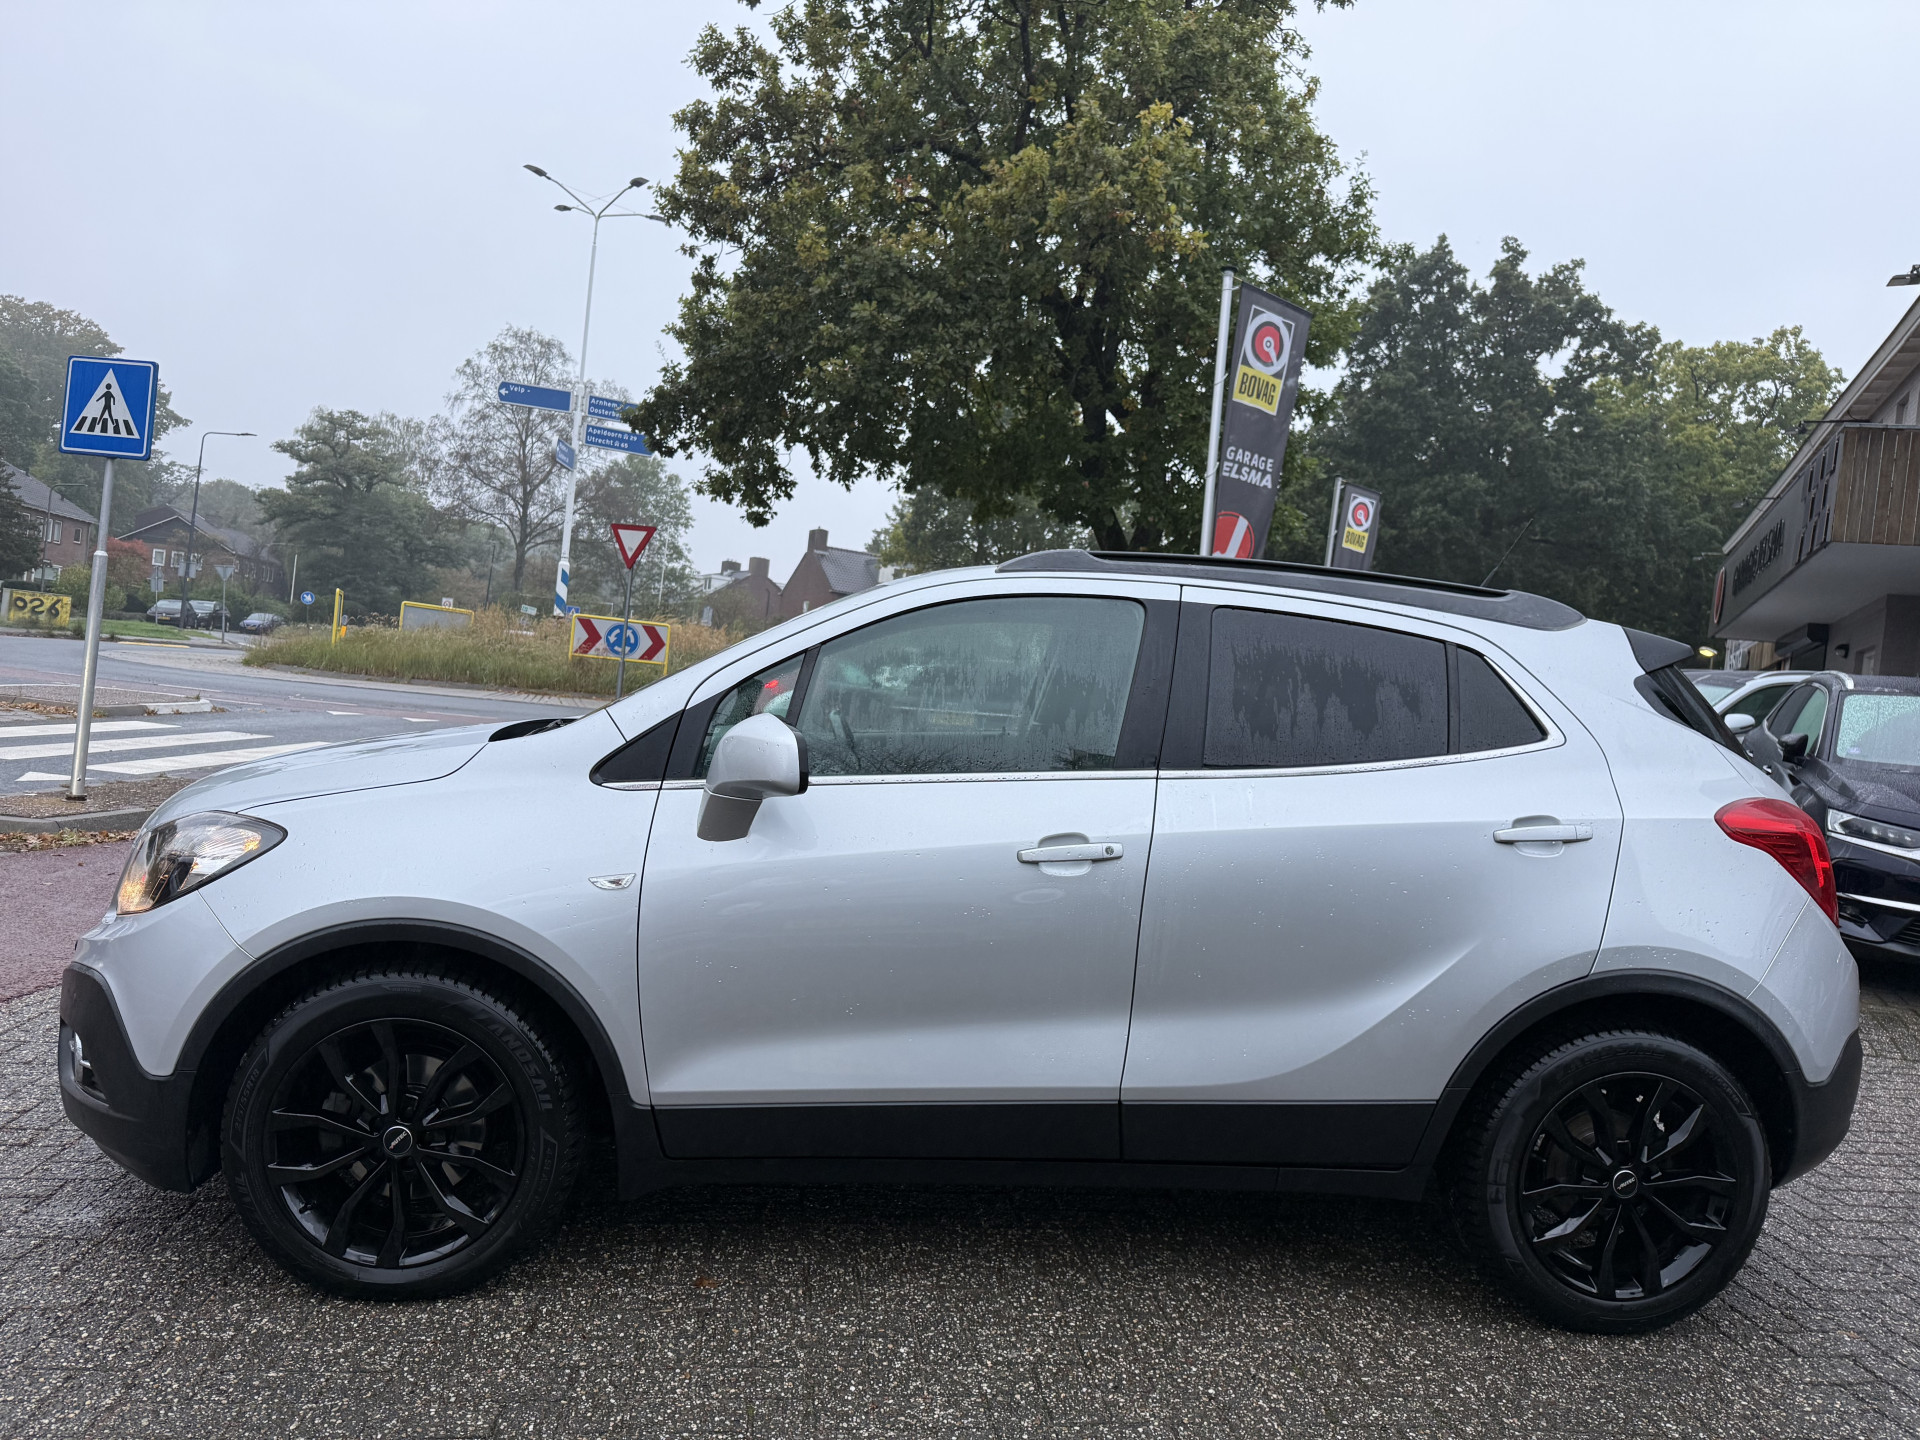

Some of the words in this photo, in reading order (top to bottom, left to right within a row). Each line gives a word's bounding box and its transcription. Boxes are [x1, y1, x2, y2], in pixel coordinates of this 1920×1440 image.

[509, 384, 525, 394] Velp
[1238, 372, 1276, 406] BOVAG
[590, 398, 618, 408] Arnhem
[586, 435, 613, 446] Utrecht
[587, 427, 622, 440] Apeldoorn
[1226, 446, 1274, 472] GARAGE
[1222, 461, 1272, 489] ELSMA
[1345, 530, 1366, 548] BOVAG
[14, 596, 62, 618] 026
